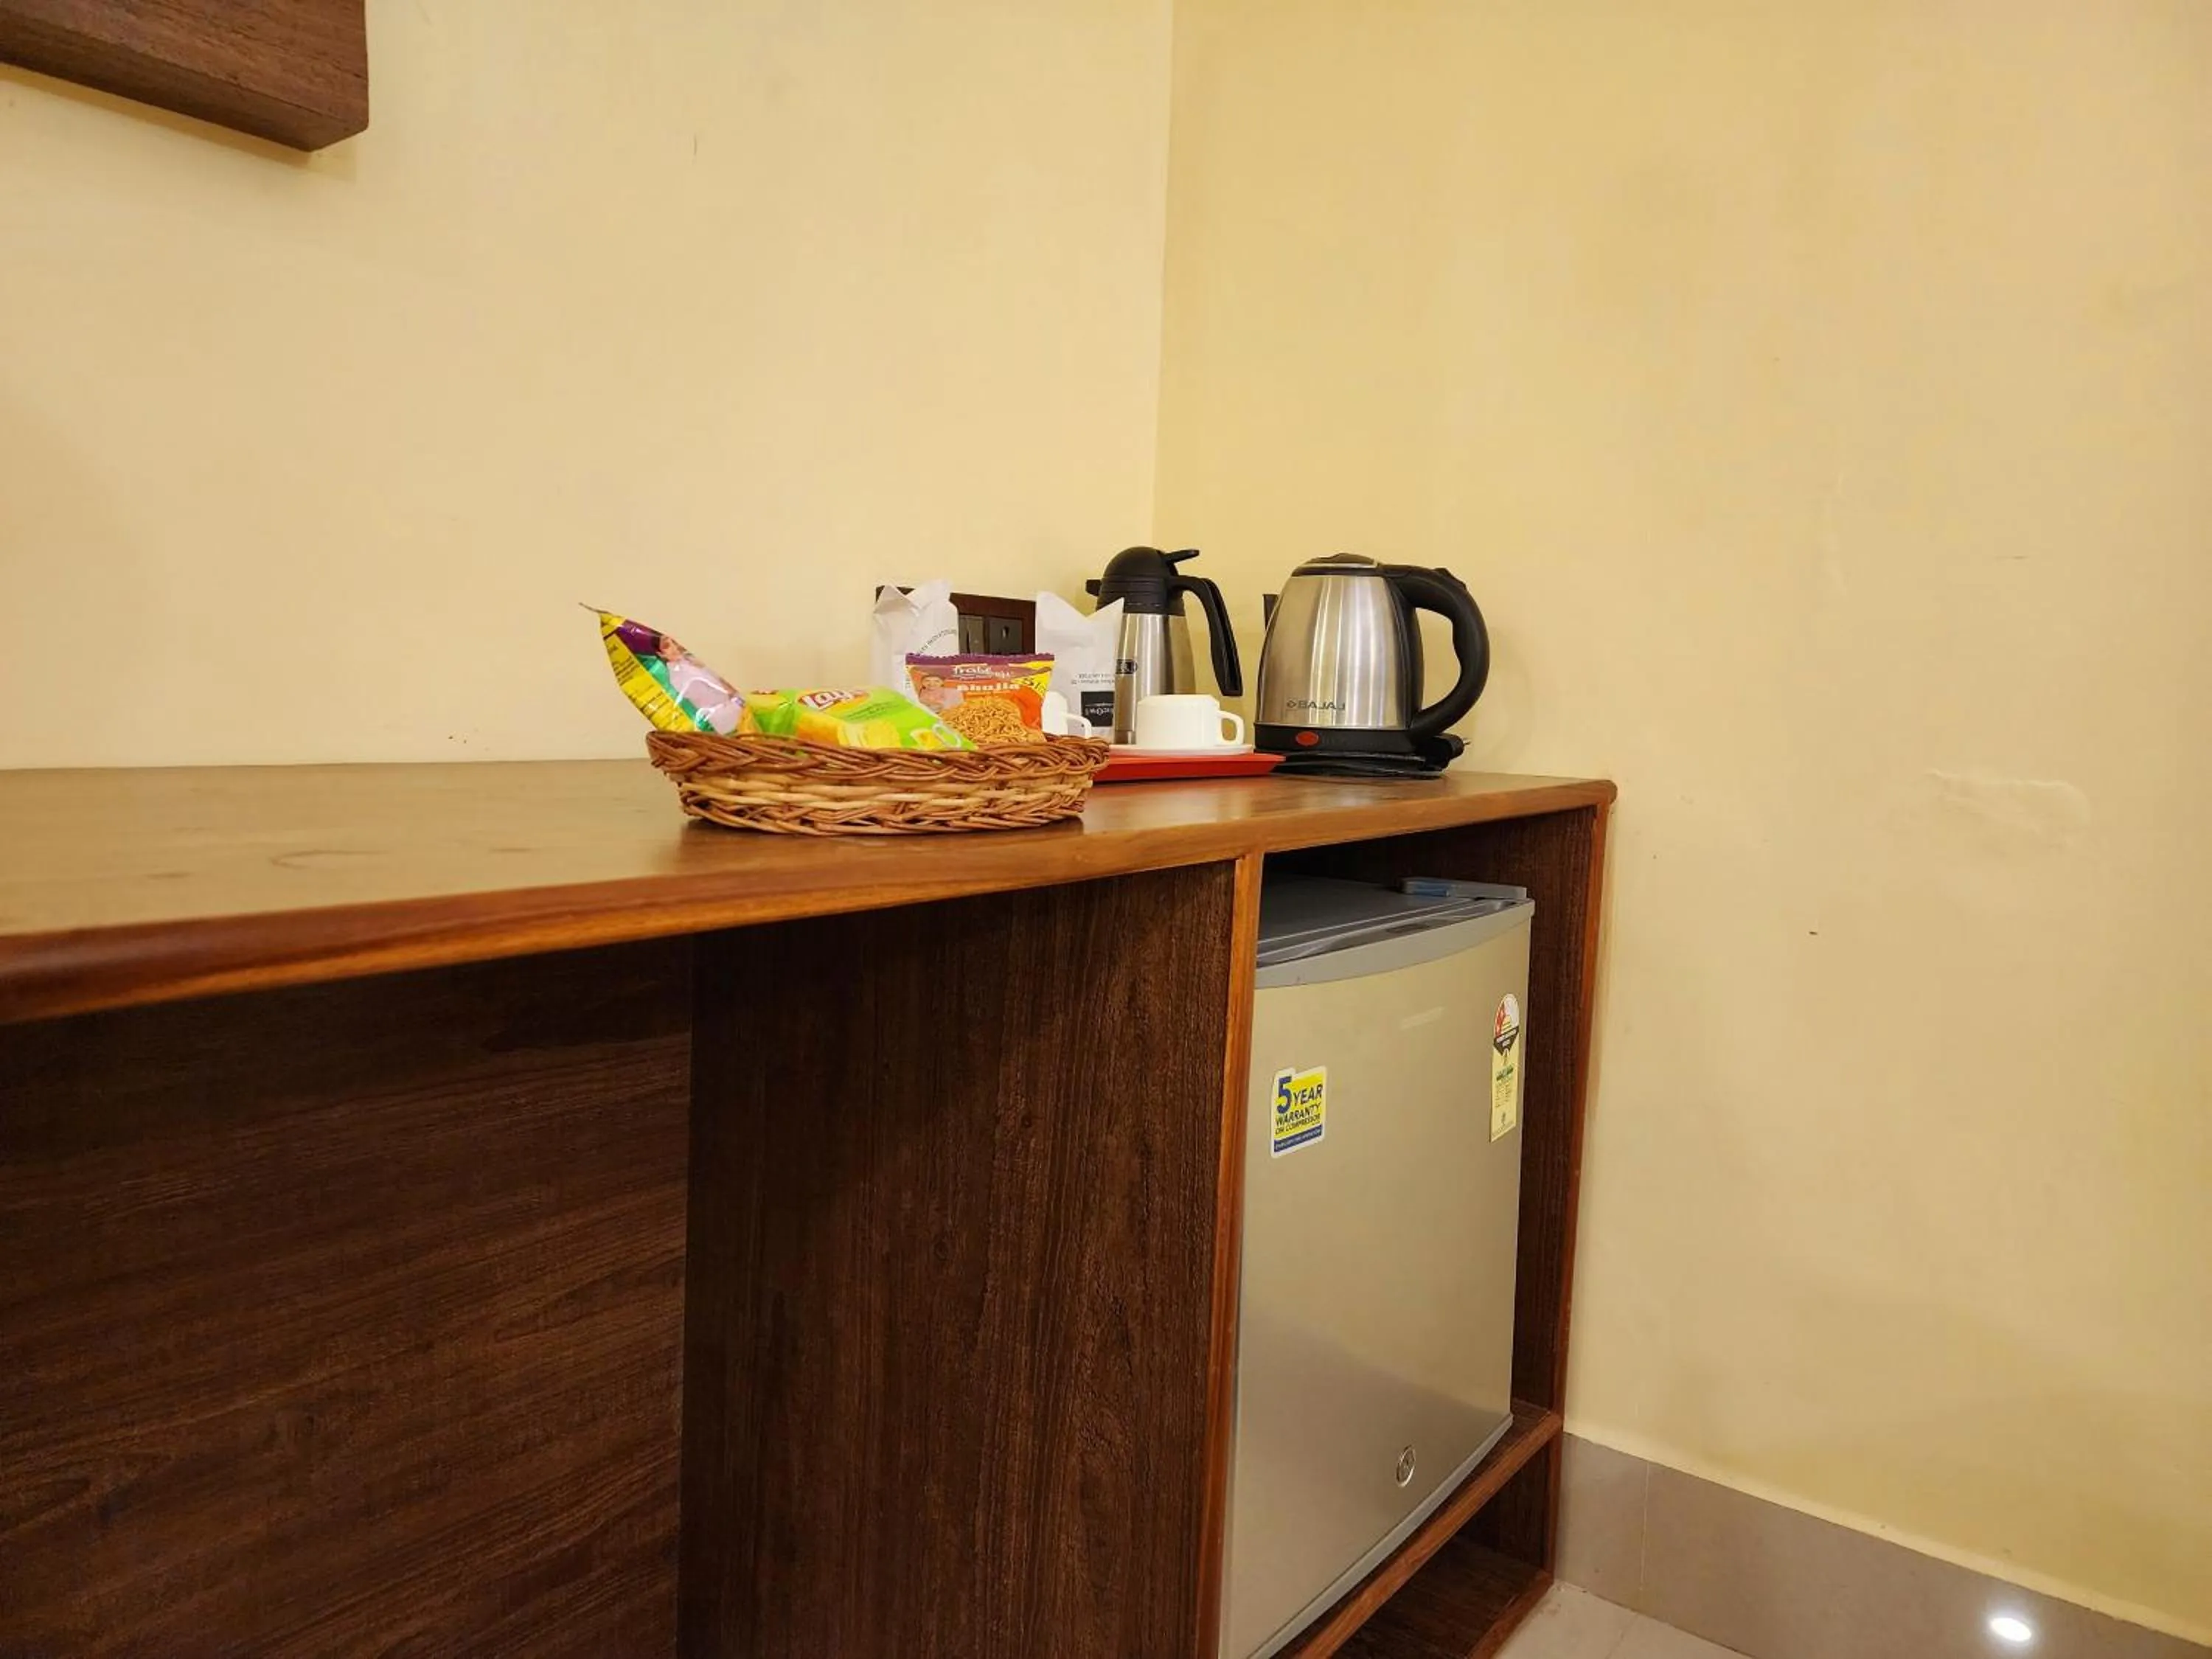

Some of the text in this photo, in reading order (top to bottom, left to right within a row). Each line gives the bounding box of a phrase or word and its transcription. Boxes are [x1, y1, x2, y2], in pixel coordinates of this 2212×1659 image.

[1298, 700, 1346, 710] BAJAJ
[1277, 1076, 1323, 1113] 5 YEAR
[1276, 1102, 1322, 1126] WARRANTY
